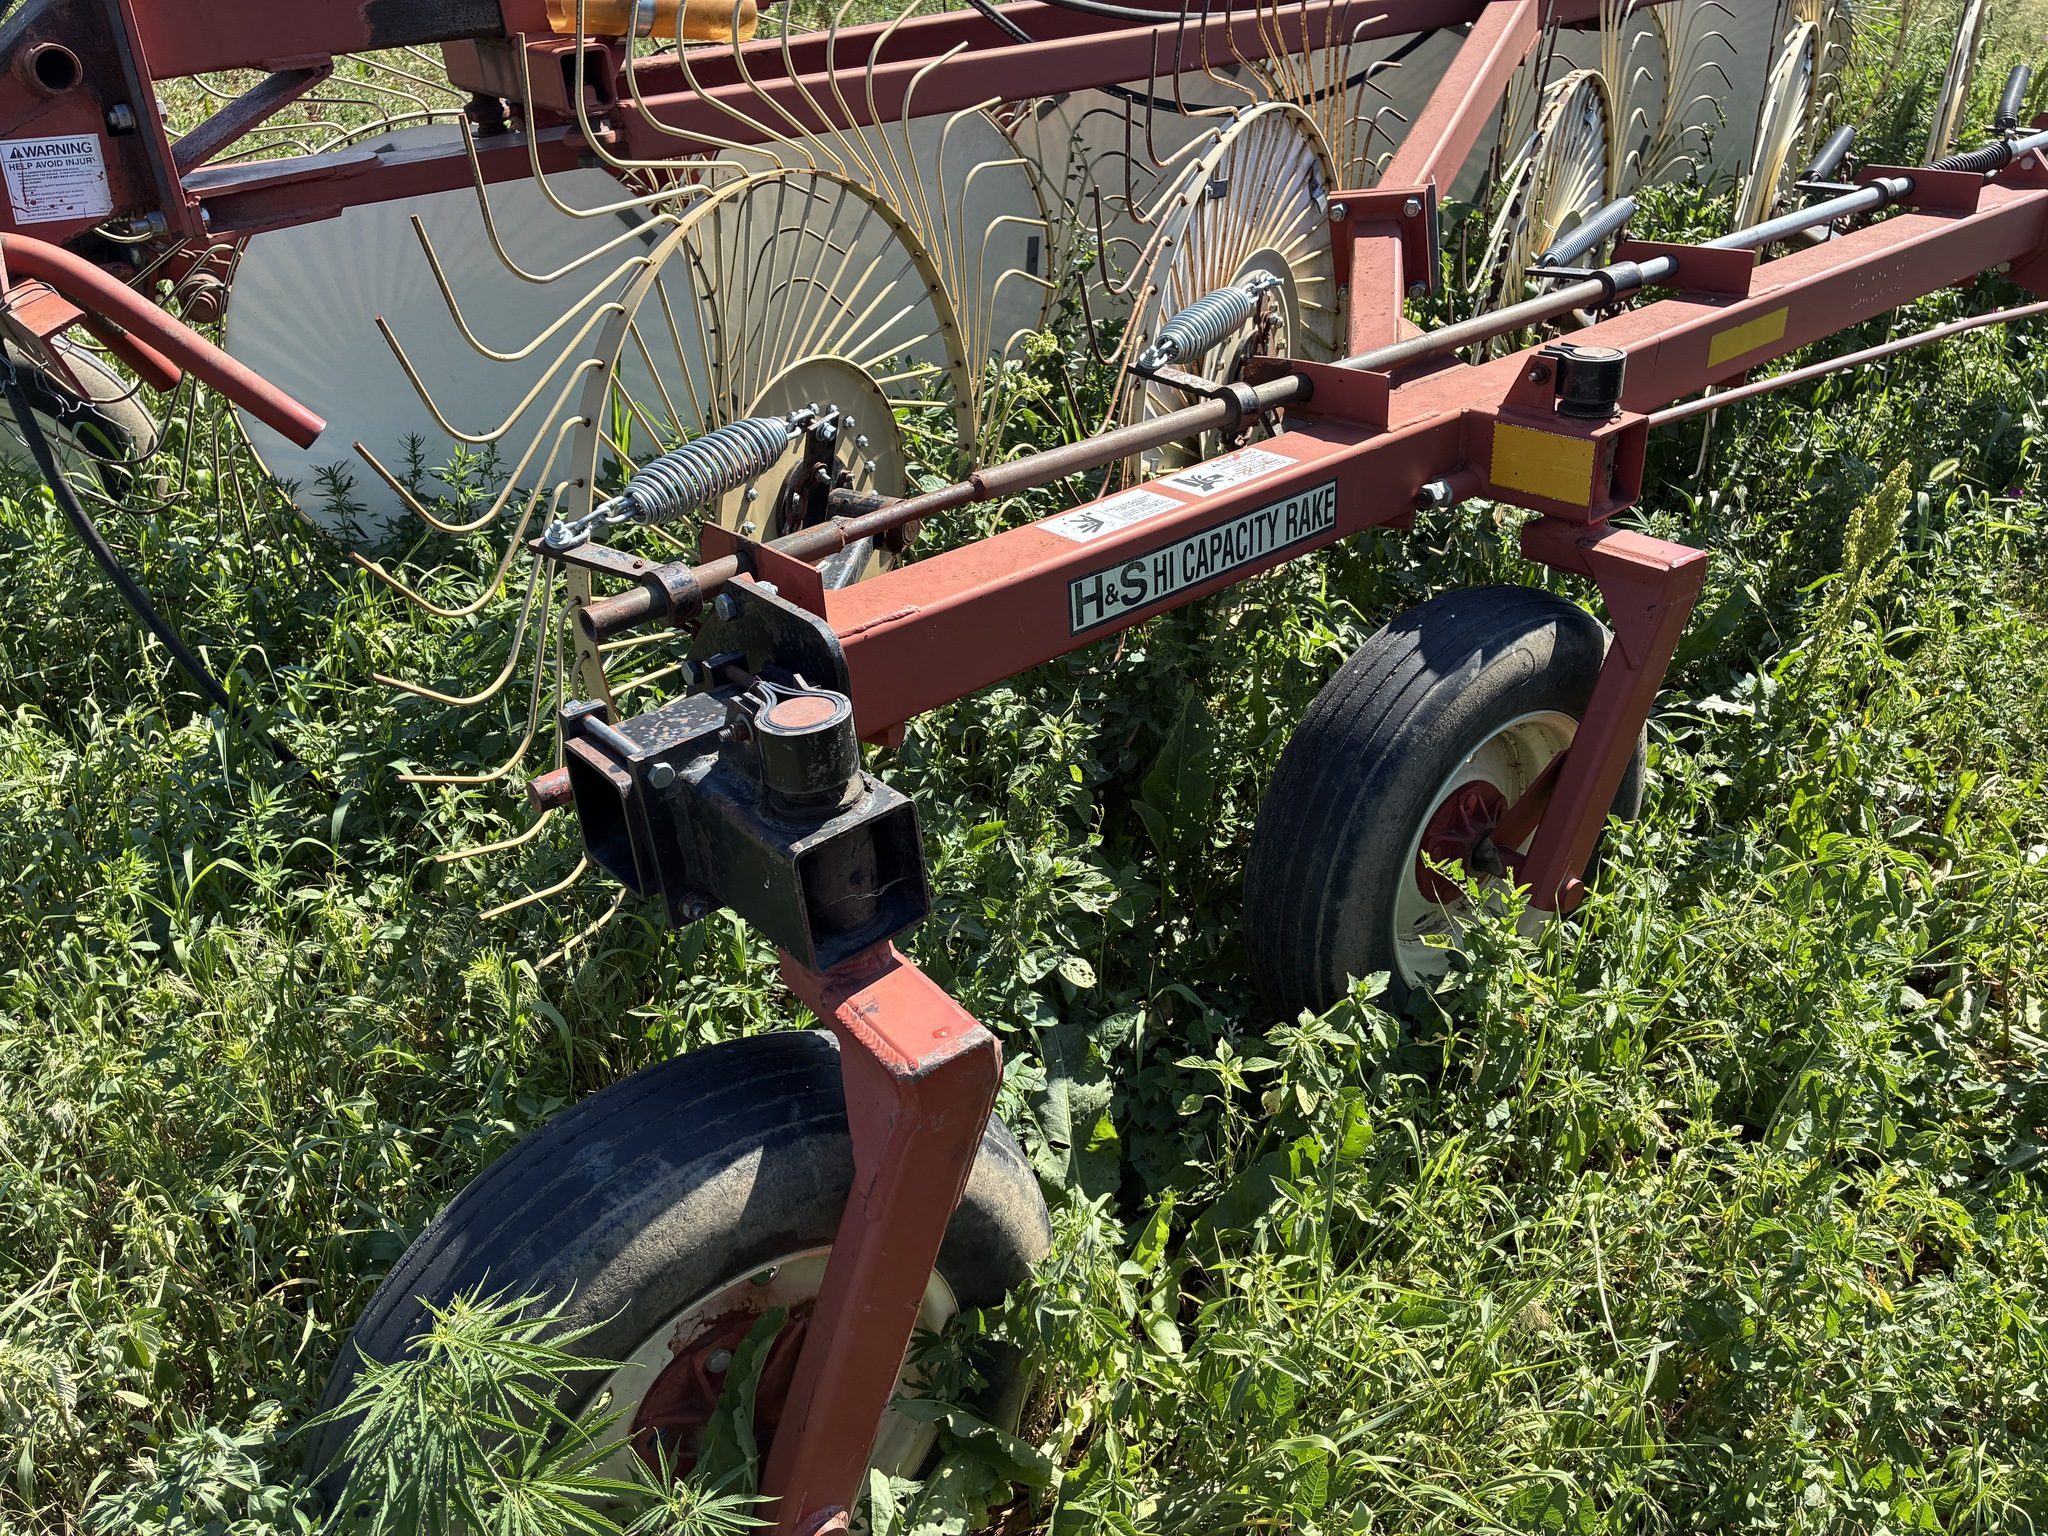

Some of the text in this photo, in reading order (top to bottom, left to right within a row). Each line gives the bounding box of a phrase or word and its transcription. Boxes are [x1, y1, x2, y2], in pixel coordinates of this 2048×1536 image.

[22, 142, 93, 158] WARNING
[8, 163, 33, 171] HELP
[35, 160, 63, 169] AVOID
[1074, 560, 1148, 627] H&S
[1153, 551, 1174, 596] HI
[1182, 508, 1280, 583] CAPACITY
[1285, 486, 1335, 541] RAKE
